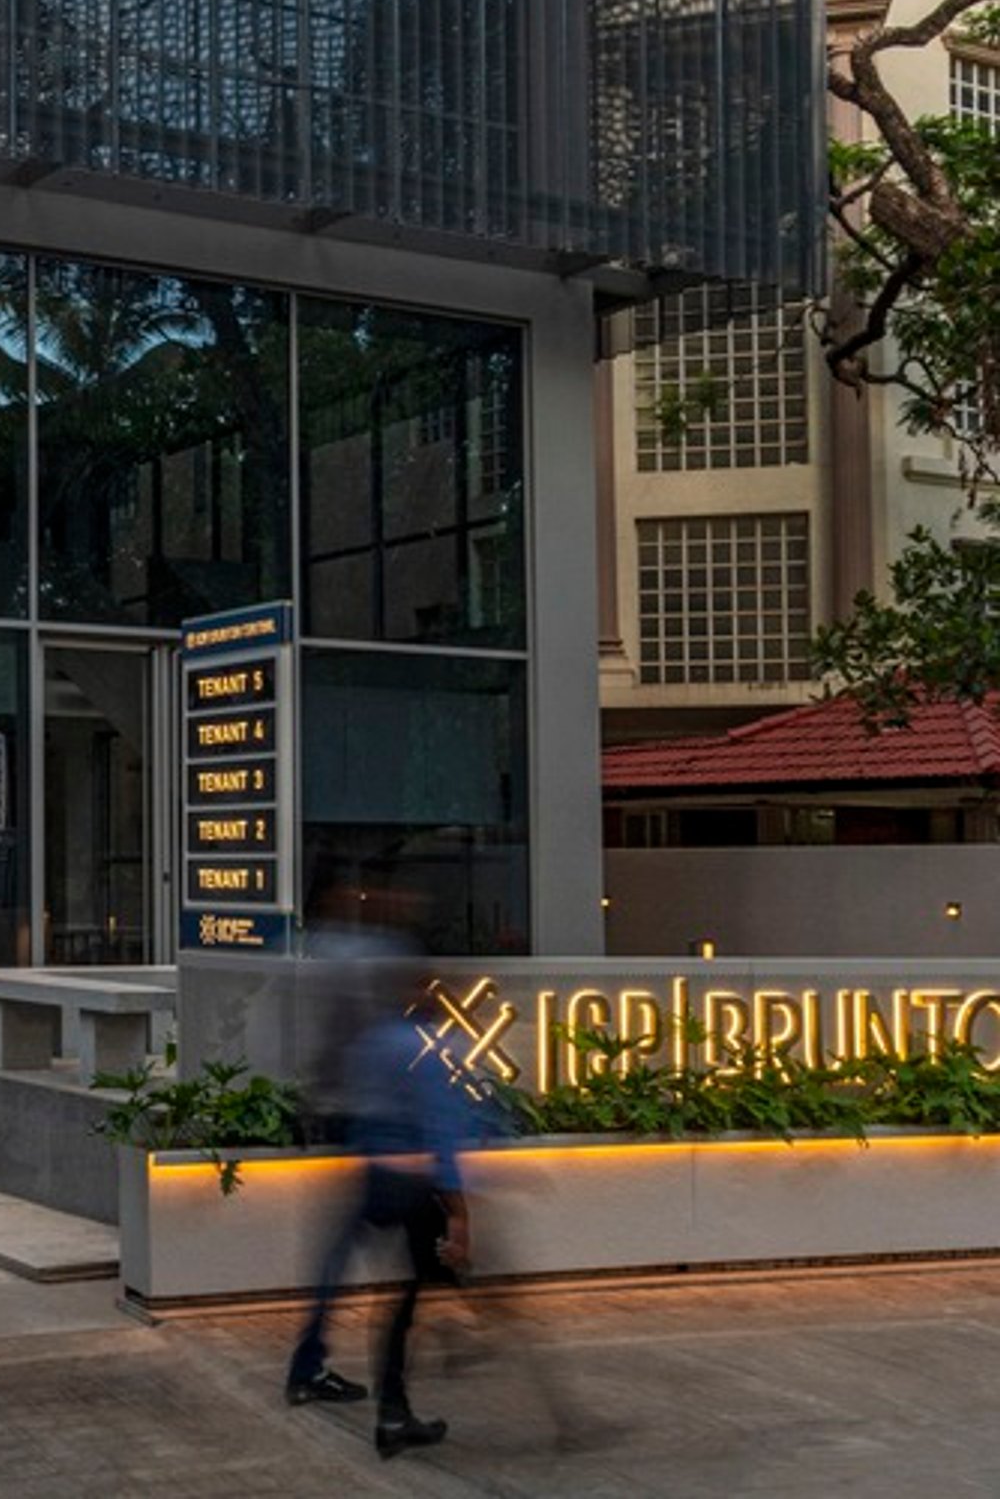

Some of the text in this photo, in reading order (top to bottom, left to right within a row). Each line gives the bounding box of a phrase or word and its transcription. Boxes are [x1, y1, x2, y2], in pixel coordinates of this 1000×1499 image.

[198, 670, 264, 697] TENANT 5
[198, 719, 264, 745] TENANT 4
[198, 769, 264, 792] TENANT 3
[198, 819, 264, 840] TENANT 2
[198, 868, 264, 890] TENANT 1
